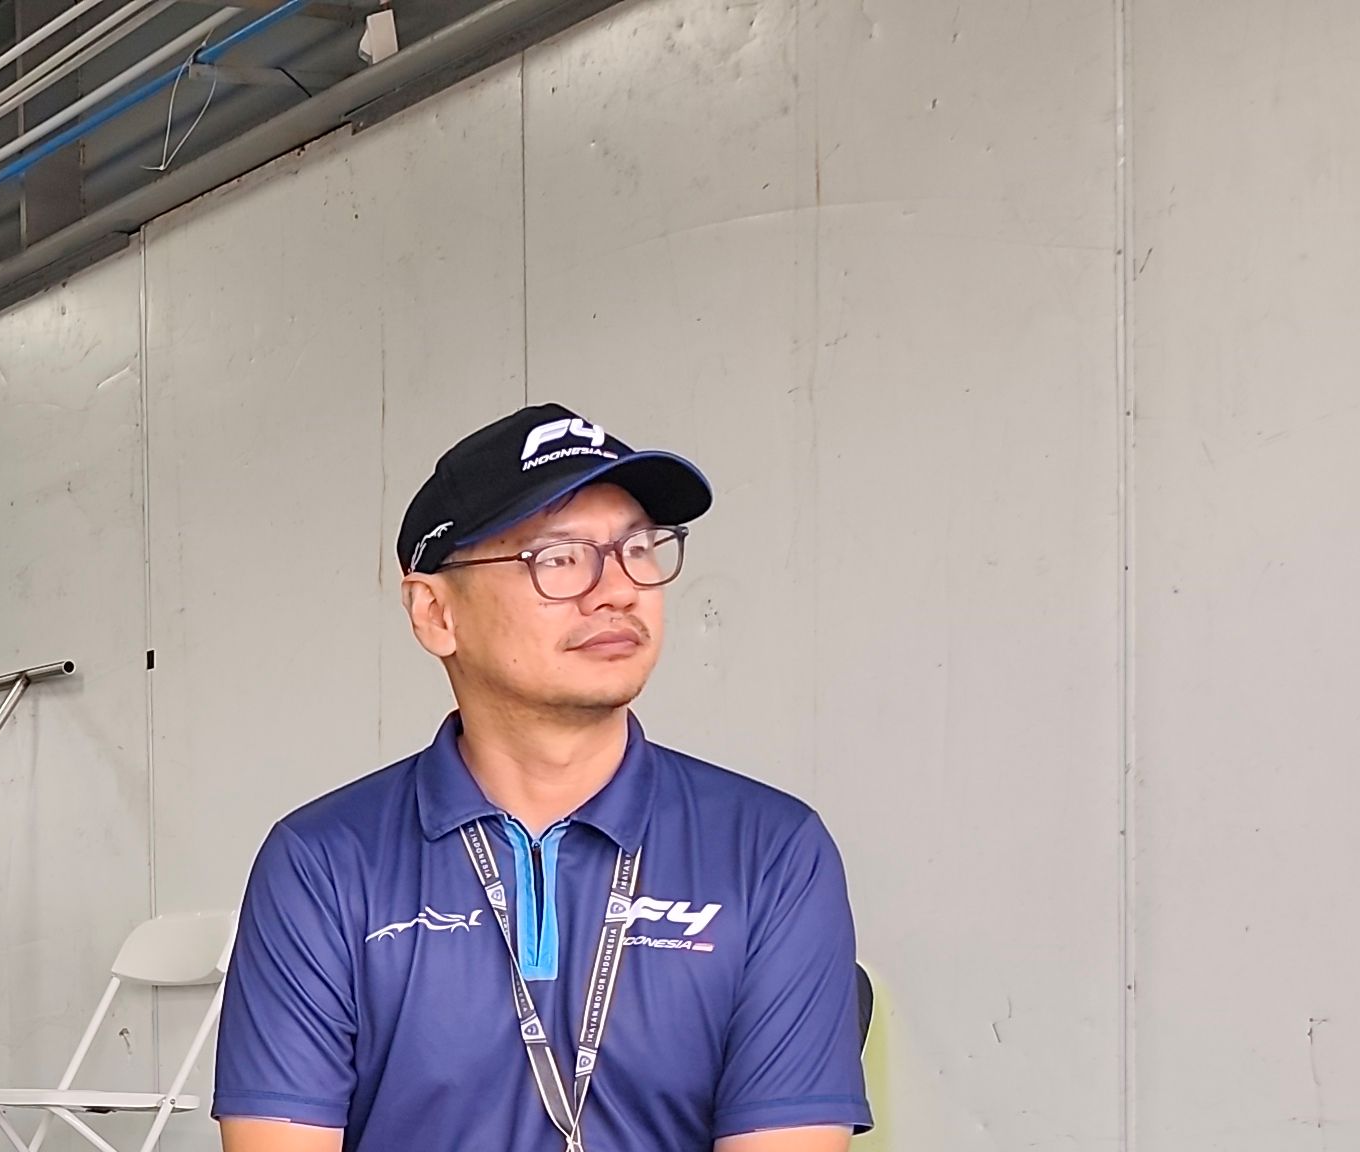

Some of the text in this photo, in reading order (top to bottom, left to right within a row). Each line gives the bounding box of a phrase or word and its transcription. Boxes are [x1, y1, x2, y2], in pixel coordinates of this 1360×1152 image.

[521, 418, 605, 460] F4
[522, 447, 603, 471] INDONESIA
[625, 896, 723, 936] F4
[594, 977, 607, 1010] MOTOR
[601, 928, 618, 977] INDONESIA
